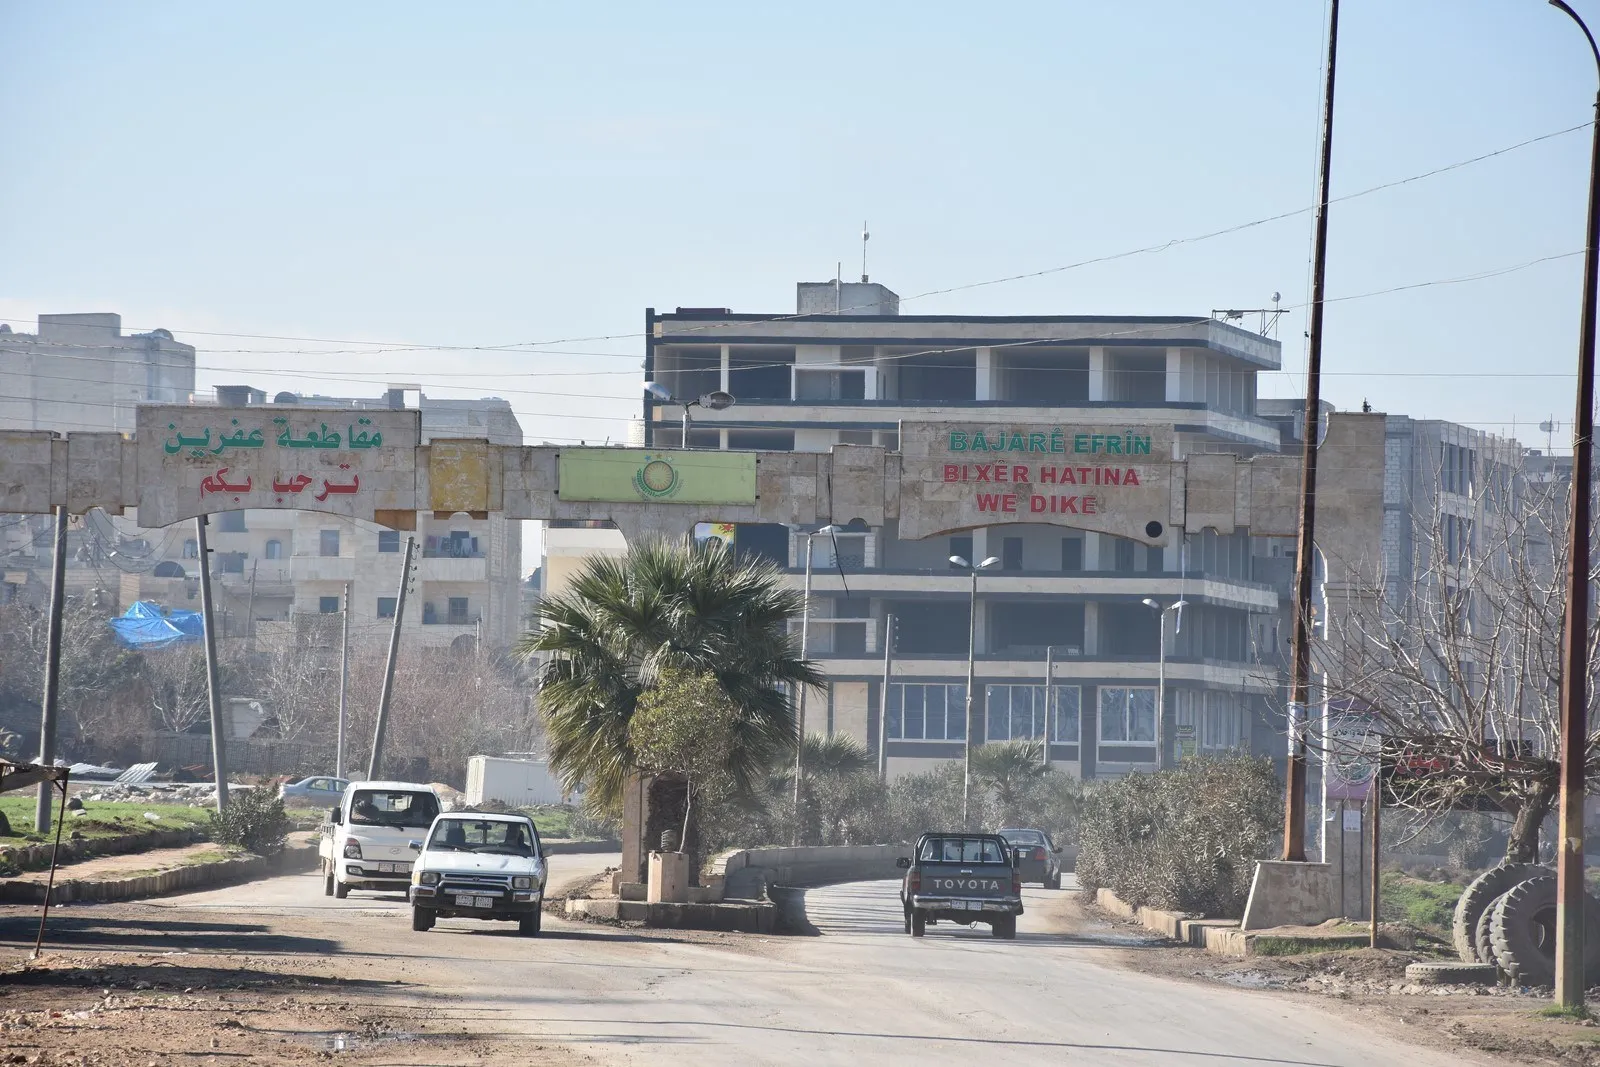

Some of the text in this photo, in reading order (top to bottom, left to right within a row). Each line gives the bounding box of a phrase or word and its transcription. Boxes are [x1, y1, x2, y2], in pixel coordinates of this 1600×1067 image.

[163, 416, 384, 458] مقاطعة عفرين
[949, 427, 1152, 456] BAJARÊ EFRÎN
[200, 463, 361, 504] ترحب بكم
[1039, 466, 1140, 487] HATINA
[976, 493, 1097, 514] WE DIKE
[934, 879, 999, 890] TOYOTA
